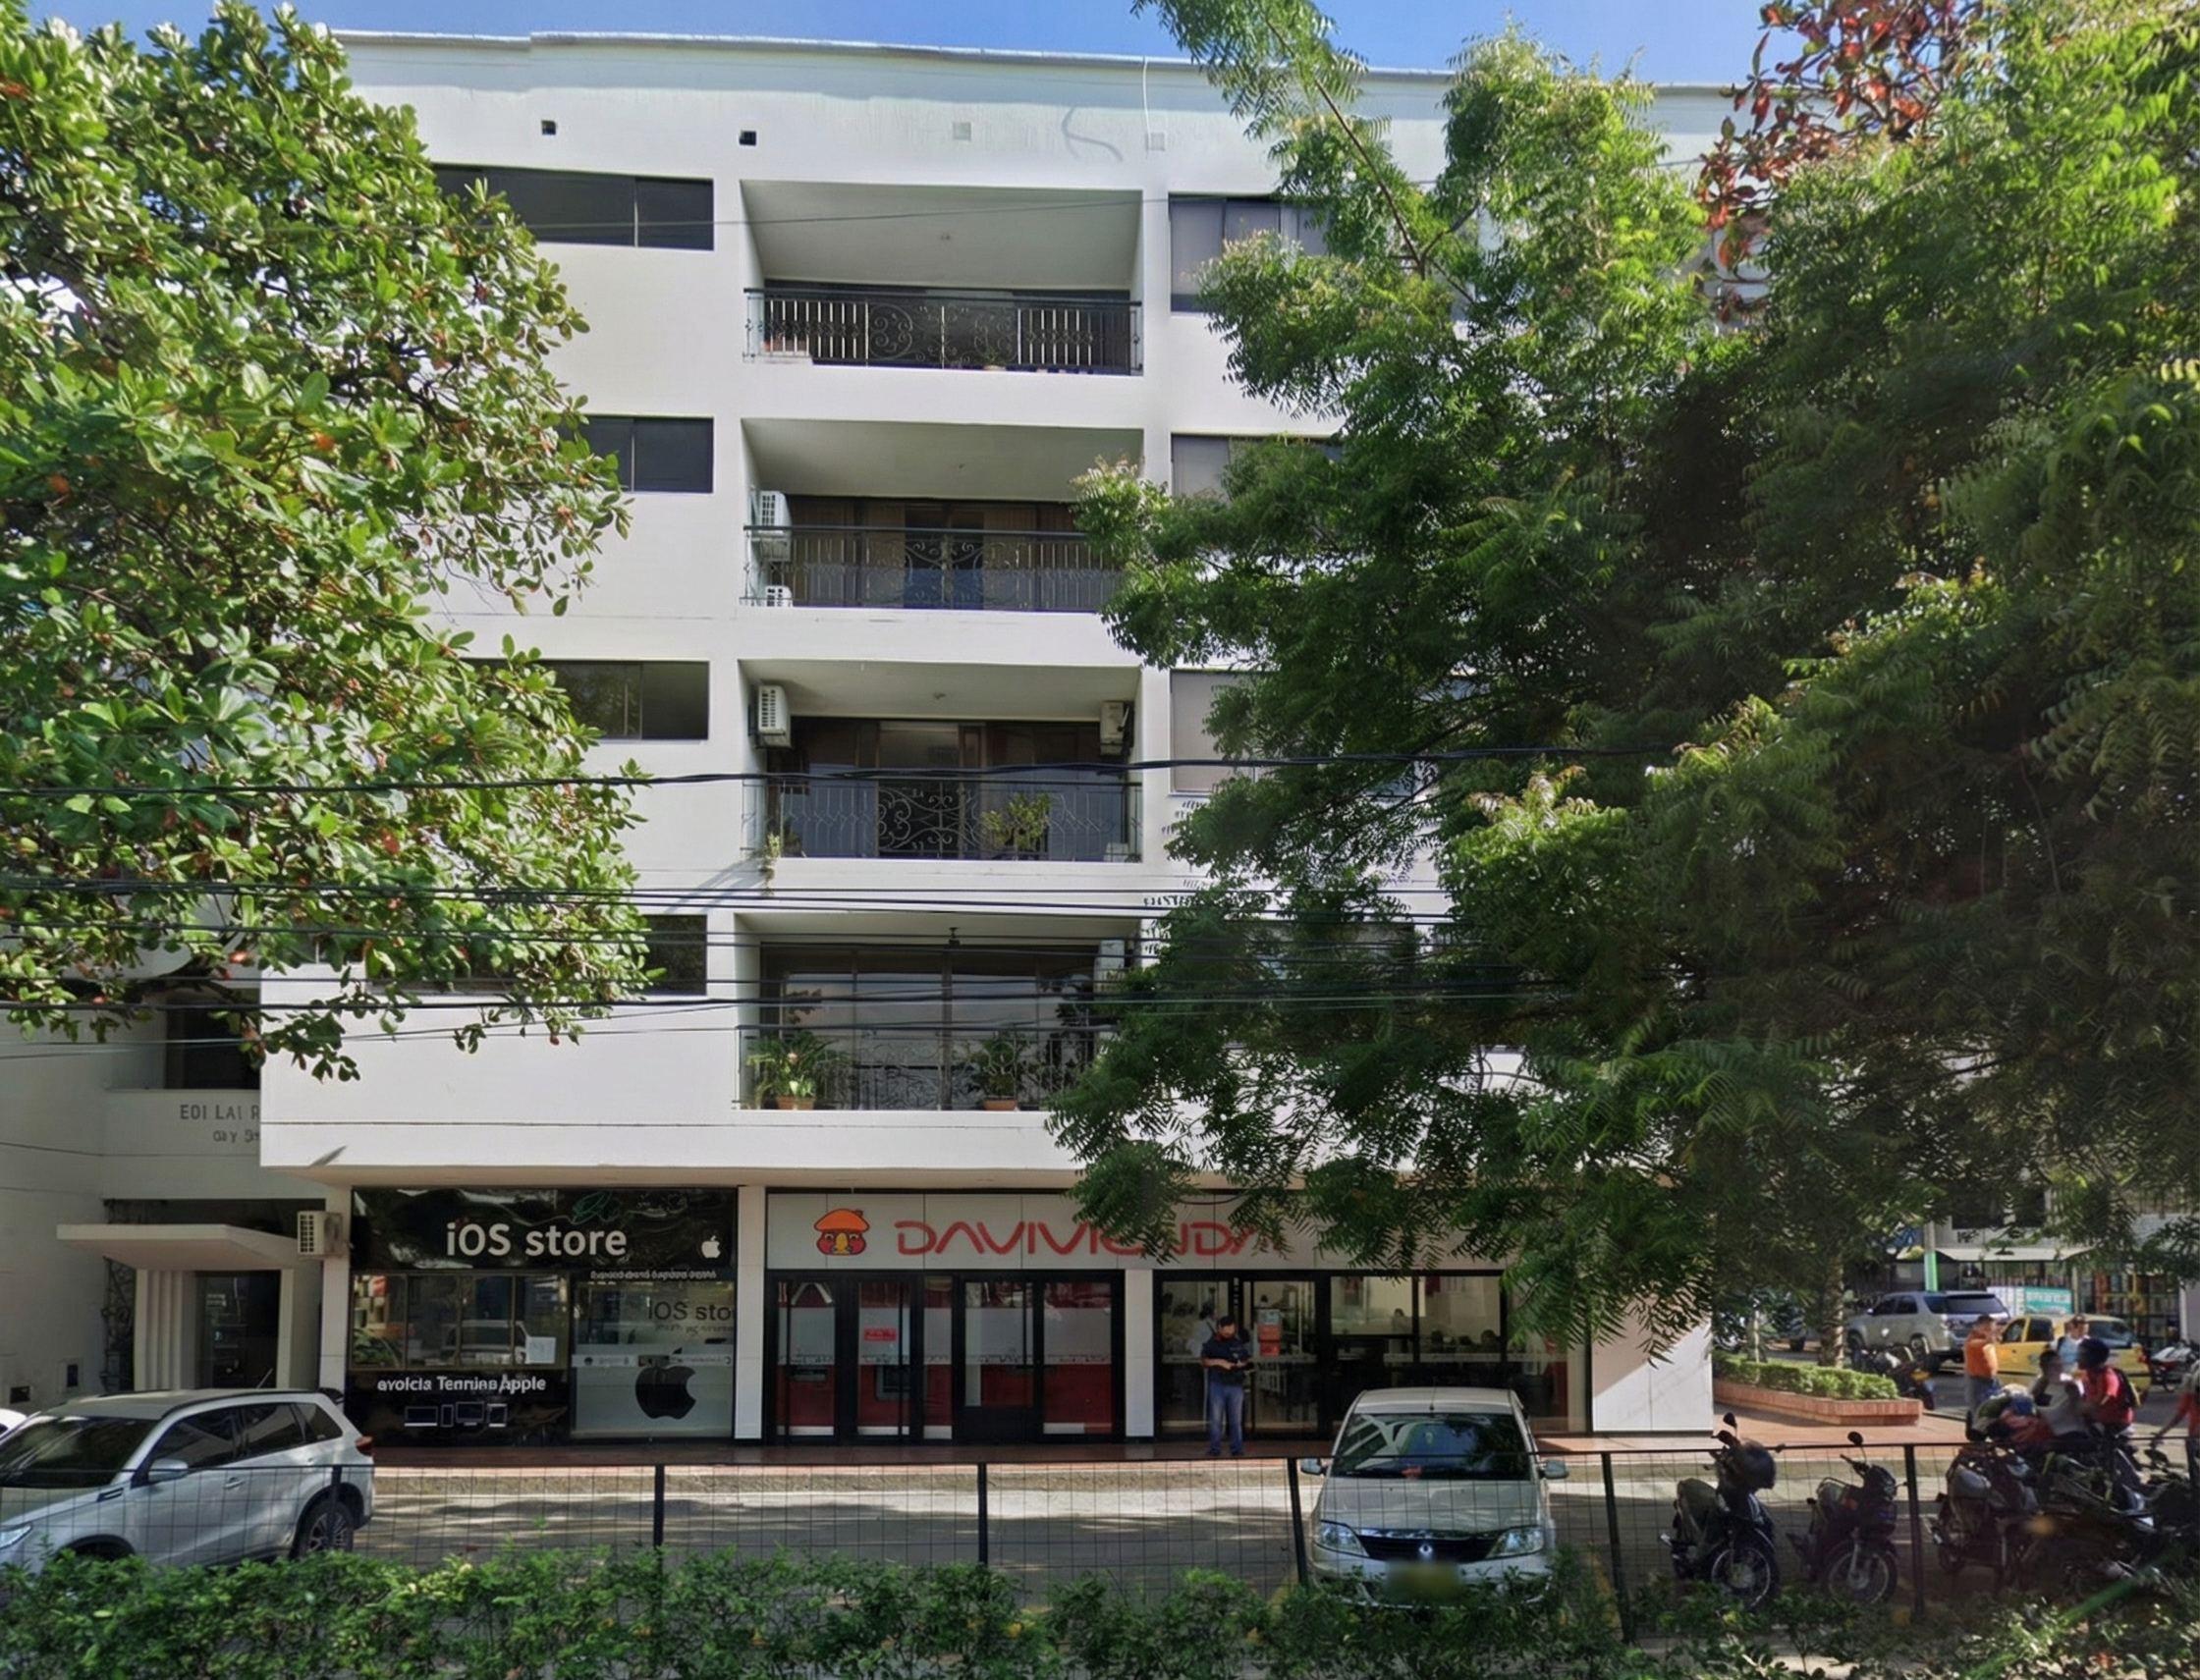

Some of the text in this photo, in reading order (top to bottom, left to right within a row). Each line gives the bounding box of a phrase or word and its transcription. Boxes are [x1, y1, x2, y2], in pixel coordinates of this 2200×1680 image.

[447, 1222, 628, 1257] iOS store
[695, 1304, 735, 1321] sto
[498, 1374, 546, 1395] Apple
